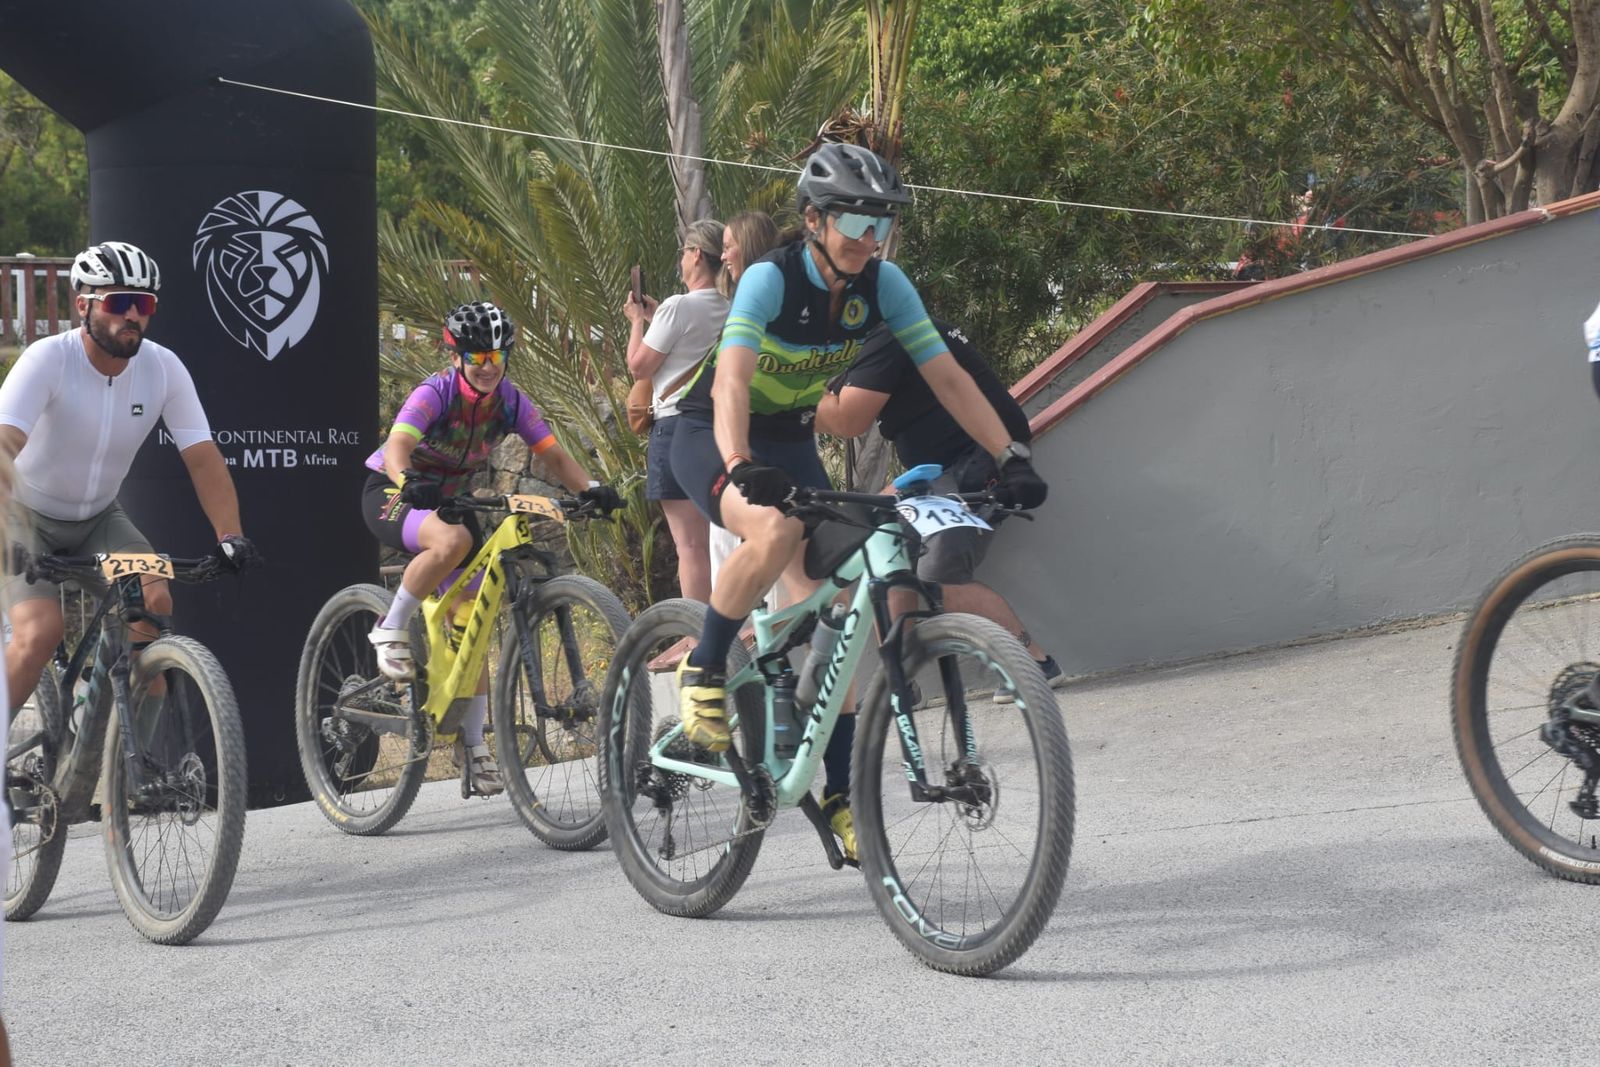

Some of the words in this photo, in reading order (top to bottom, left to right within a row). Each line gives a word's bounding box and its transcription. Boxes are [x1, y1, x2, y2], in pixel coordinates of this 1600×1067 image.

[158, 429, 324, 445] INONTINENTAL
[329, 428, 359, 445] RACE
[243, 449, 298, 468] MTB
[303, 454, 338, 466] Africa
[109, 559, 168, 575] 273-2
